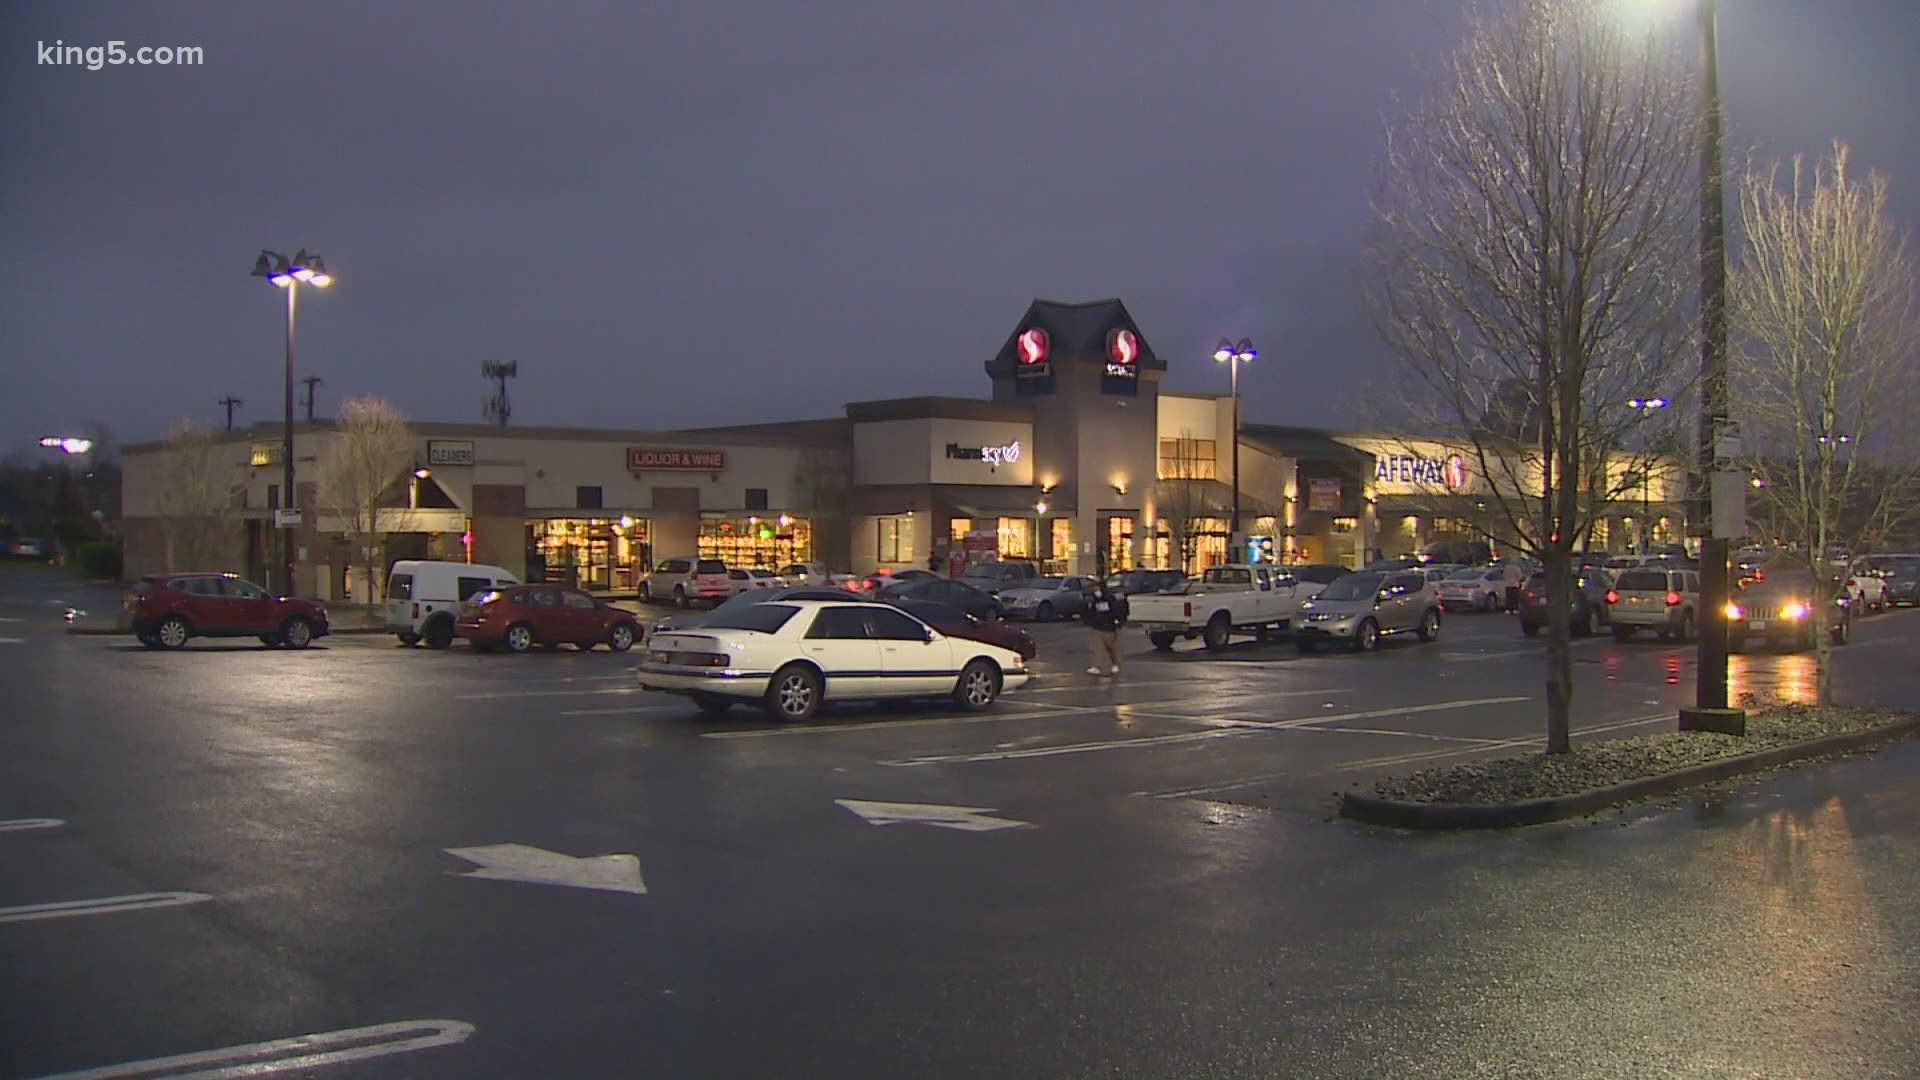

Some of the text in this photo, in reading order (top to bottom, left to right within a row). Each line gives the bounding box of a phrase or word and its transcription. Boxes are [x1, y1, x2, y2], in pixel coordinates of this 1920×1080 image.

[431, 448, 472, 462] CLEANERS
[635, 452, 721, 466] LIQUOR & WINE
[1375, 453, 1445, 483] AFEWAY
